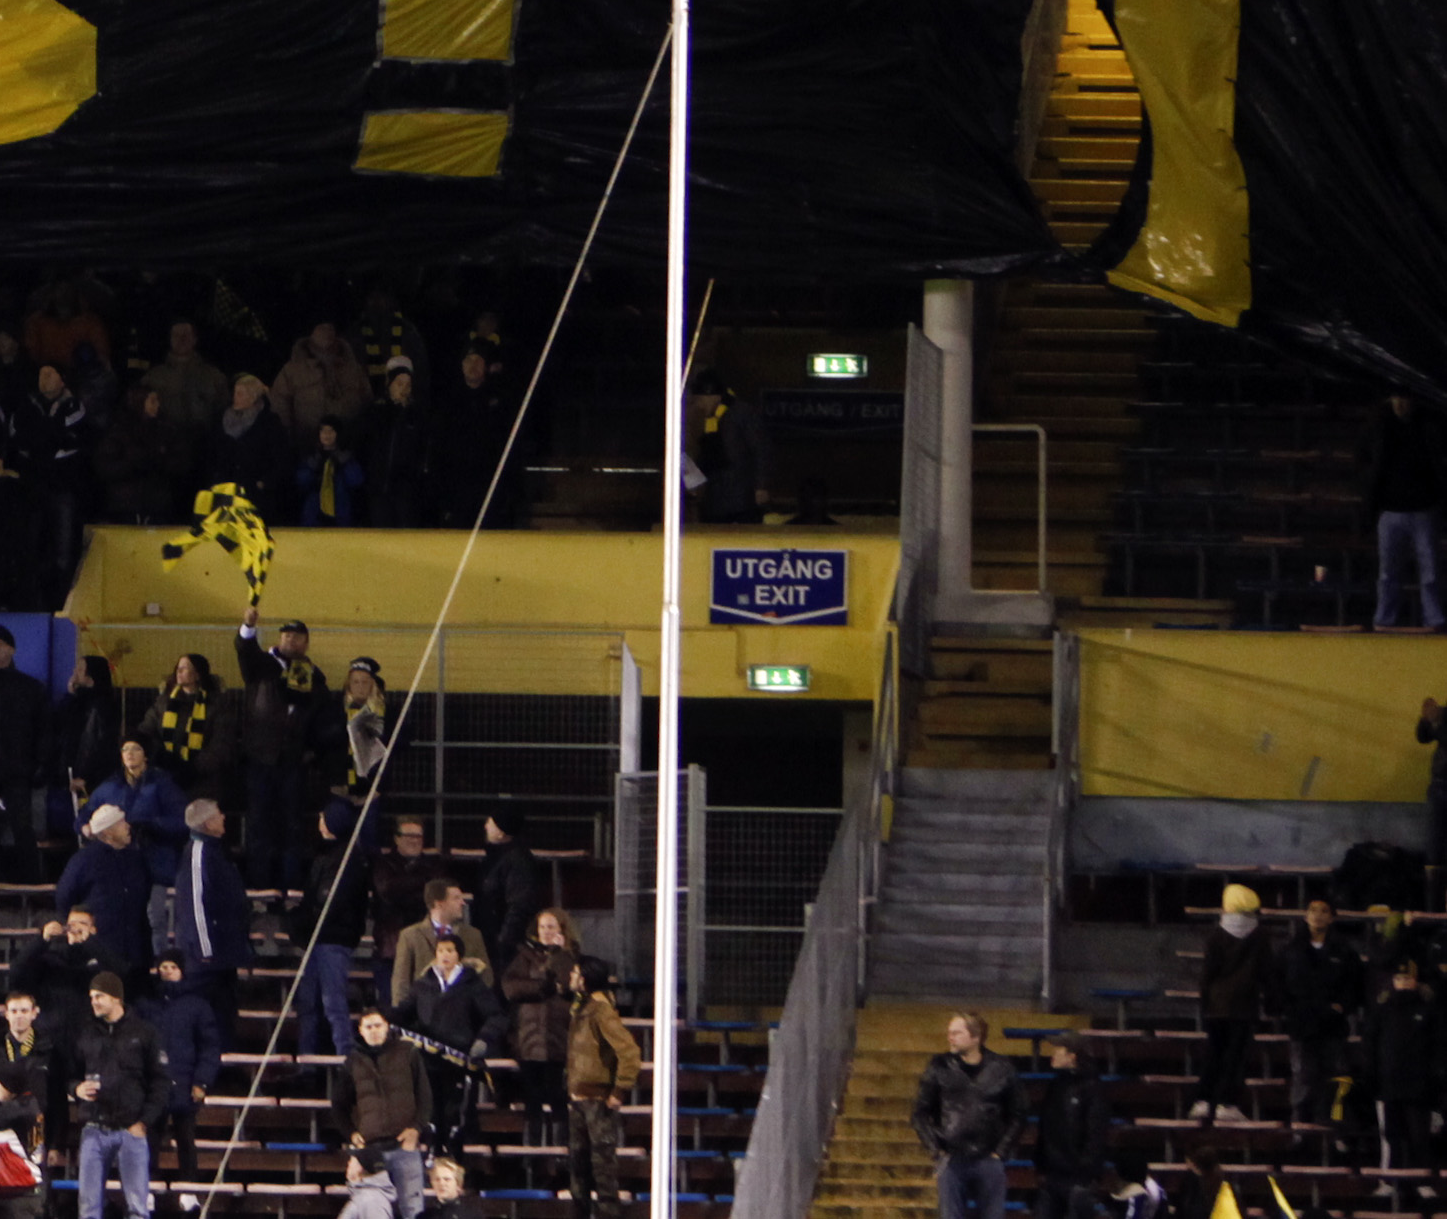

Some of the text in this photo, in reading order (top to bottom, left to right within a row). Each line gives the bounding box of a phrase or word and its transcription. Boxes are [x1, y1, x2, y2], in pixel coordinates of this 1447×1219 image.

[861, 402, 902, 419] EXIT
[724, 552, 834, 580] UTGÅNG
[754, 585, 812, 606] EXIT
